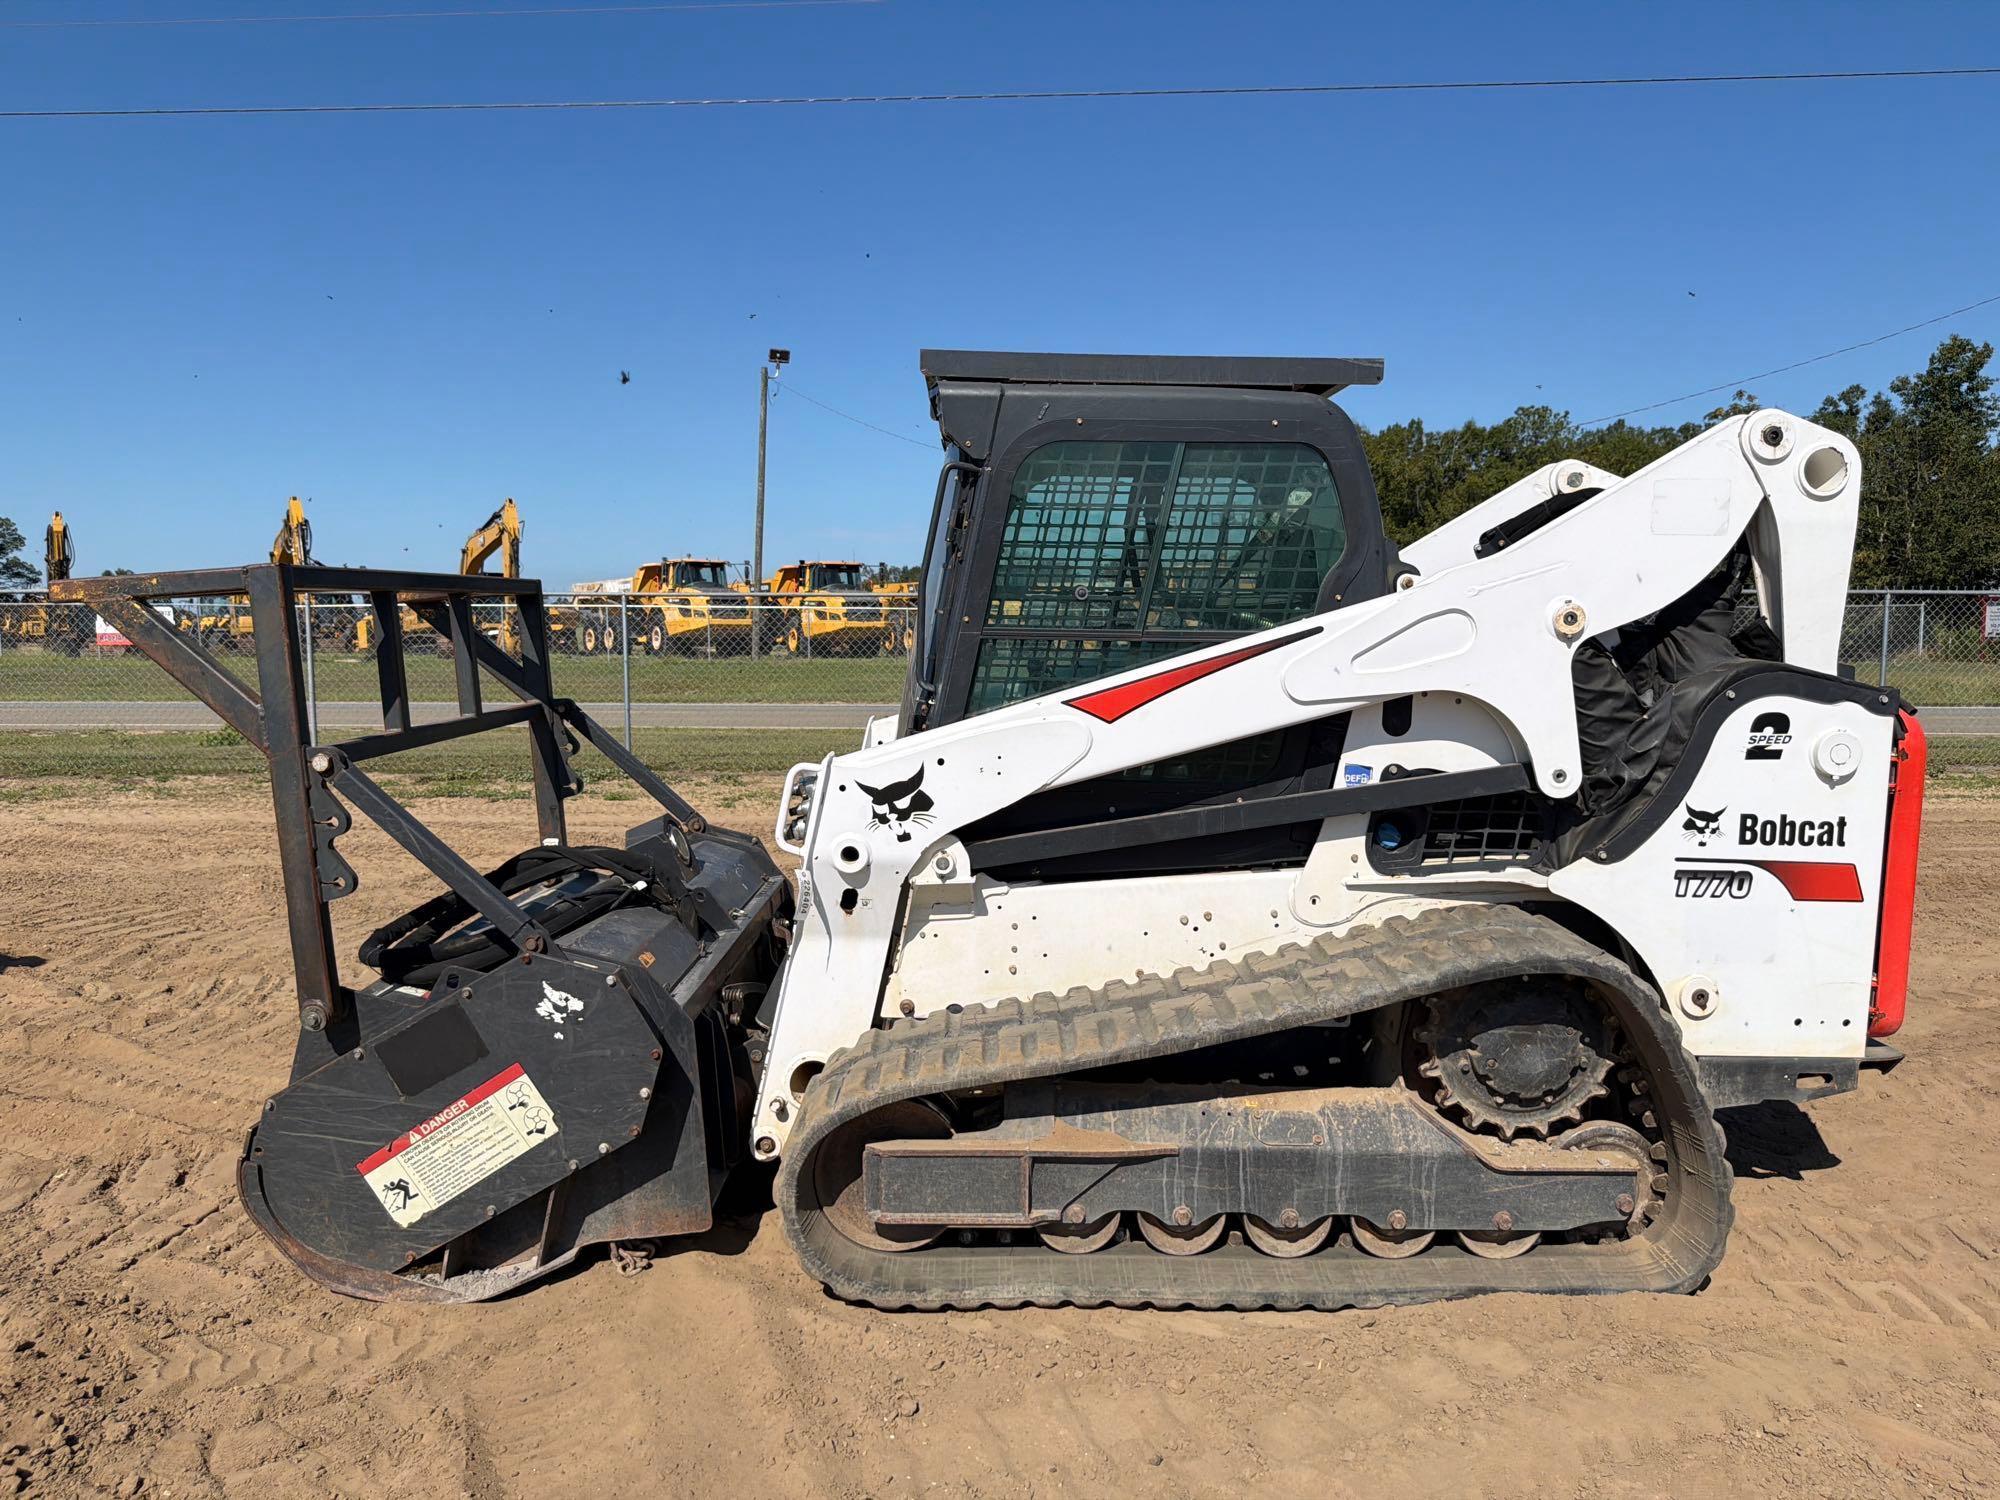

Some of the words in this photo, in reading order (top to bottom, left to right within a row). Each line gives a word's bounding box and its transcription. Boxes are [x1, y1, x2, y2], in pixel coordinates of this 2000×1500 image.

[1744, 711, 1791, 760] 2
[1747, 735, 1793, 745] SPEED
[1345, 774, 1361, 783] DEF
[1738, 813, 1847, 847] Bobcat
[1674, 869, 1753, 899] T770
[419, 1099, 470, 1135] DANGER
